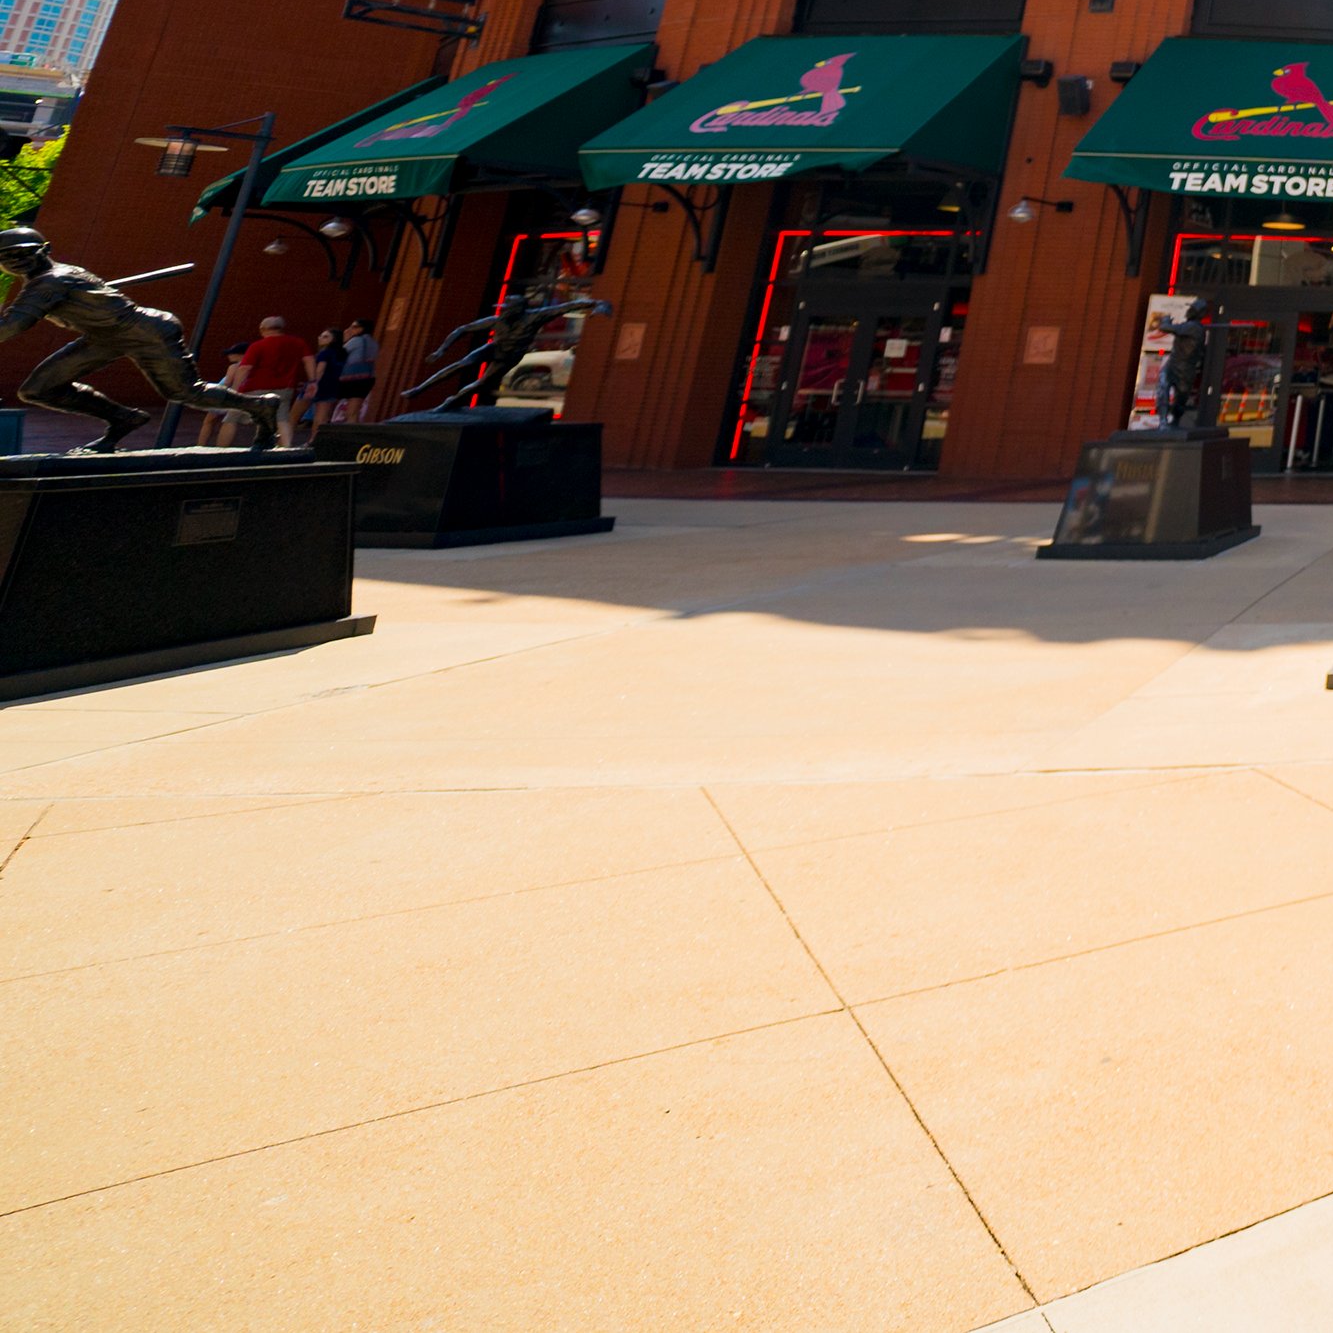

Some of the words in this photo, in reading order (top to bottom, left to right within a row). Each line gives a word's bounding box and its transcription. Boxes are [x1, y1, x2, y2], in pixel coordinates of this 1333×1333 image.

[689, 100, 840, 133] Cardinals
[650, 153, 714, 162] OFFICIAL
[722, 153, 801, 162] CARDINALS
[1172, 162, 1248, 172] OFFICIAL
[637, 162, 707, 180] TEAM
[705, 162, 793, 180] STORE
[303, 178, 348, 197] TEAM
[345, 175, 397, 196] STORE
[1169, 172, 1249, 193] TEAM
